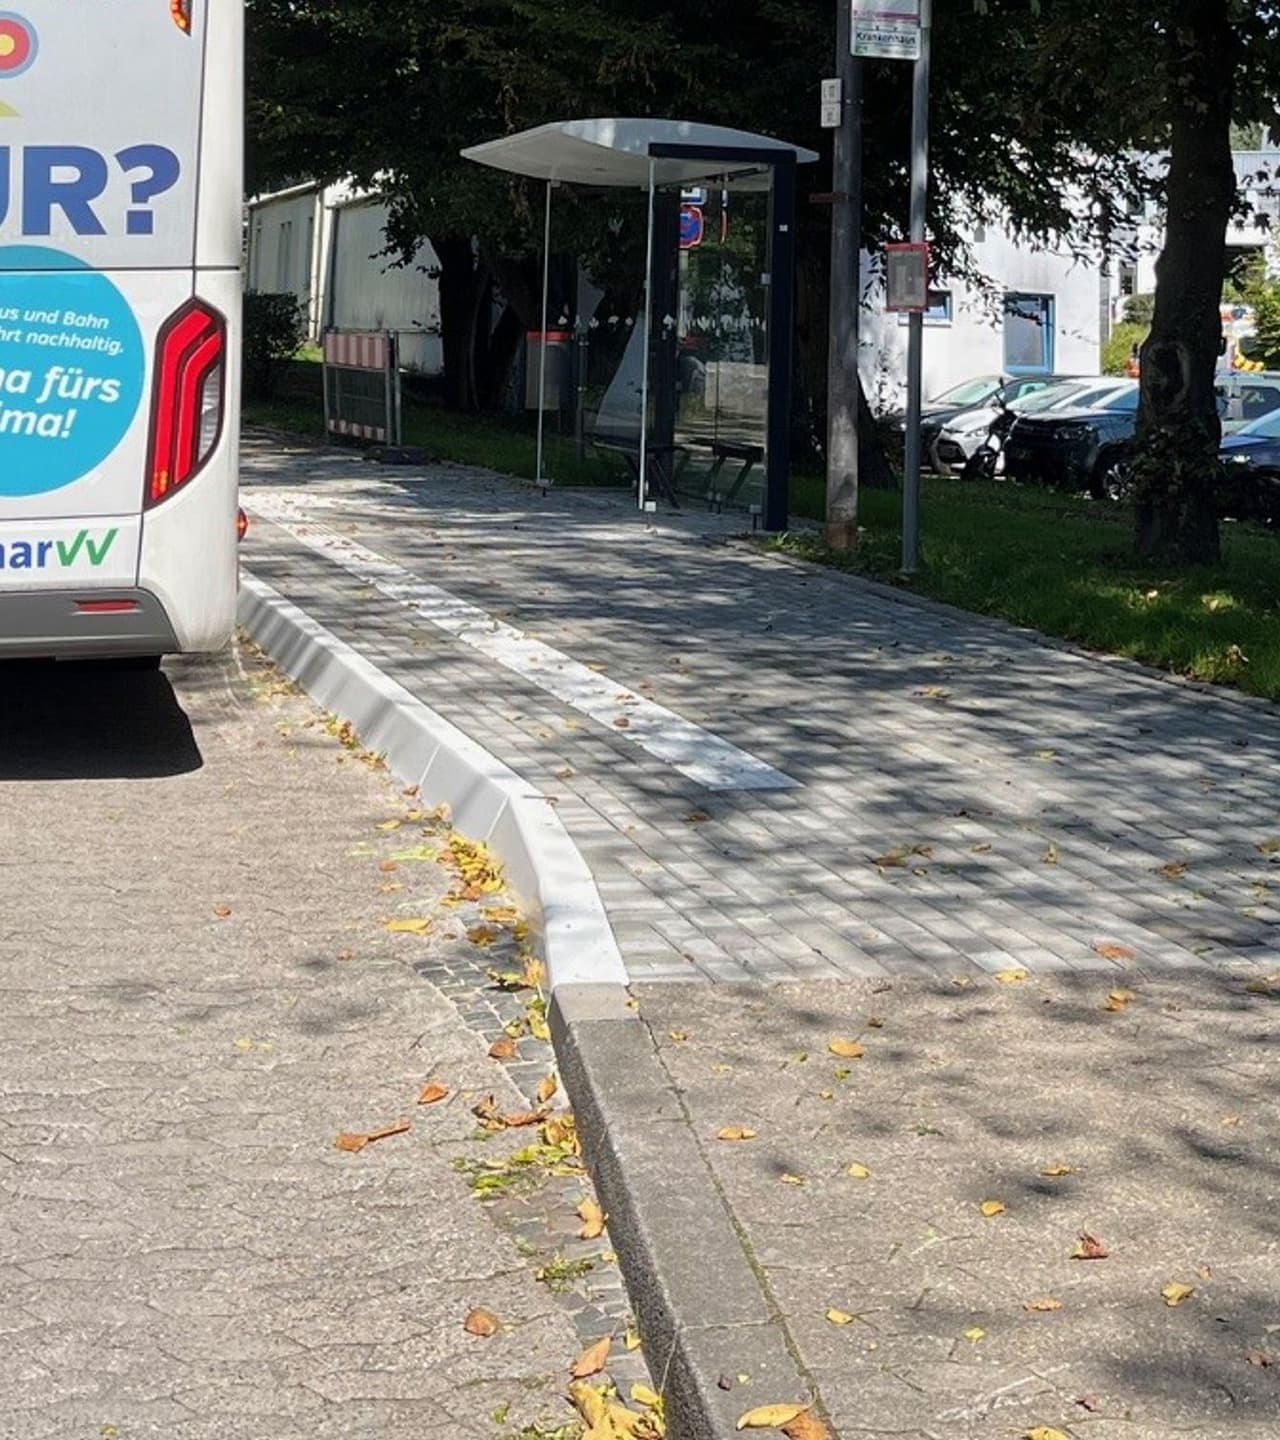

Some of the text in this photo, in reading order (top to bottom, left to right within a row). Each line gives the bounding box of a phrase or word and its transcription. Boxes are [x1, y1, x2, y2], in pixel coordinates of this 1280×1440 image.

[24, 309, 59, 325] und
[63, 311, 109, 329] Bahn
[26, 331, 124, 356] nachhaltig.
[35, 366, 122, 404] fürs
